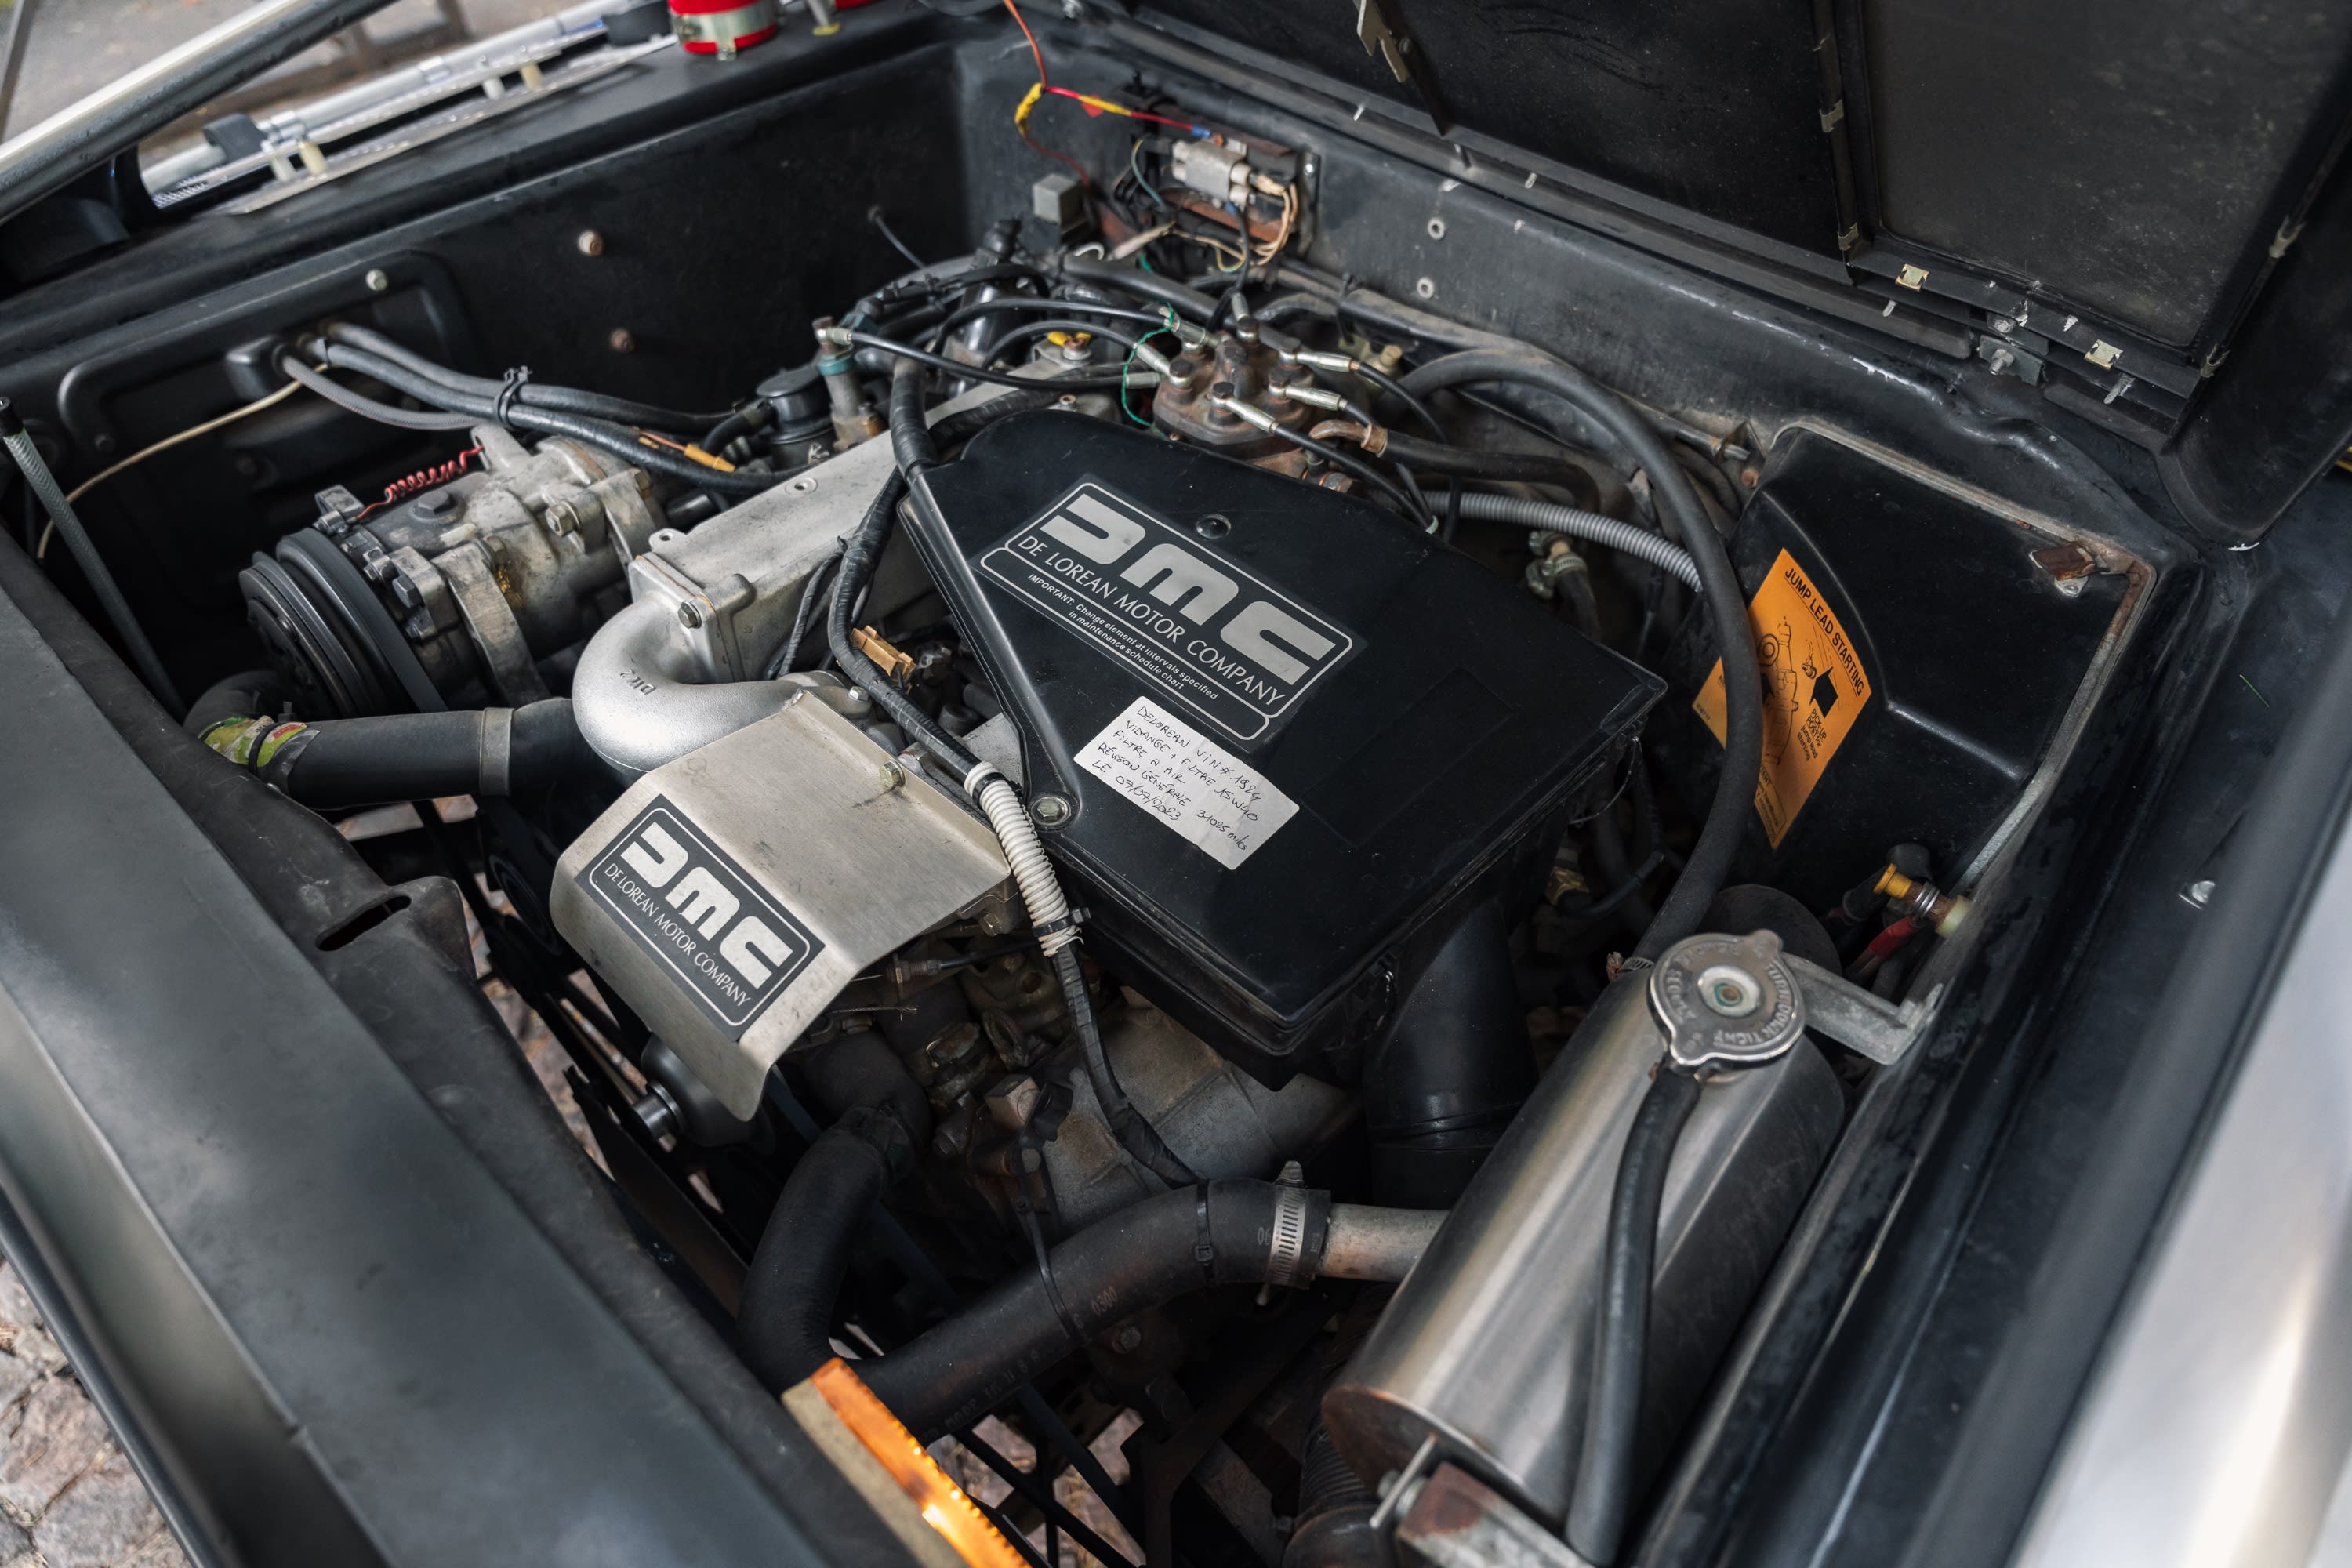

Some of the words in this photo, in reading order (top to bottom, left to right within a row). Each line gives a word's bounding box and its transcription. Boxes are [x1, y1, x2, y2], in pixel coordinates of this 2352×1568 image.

[1018, 535, 1047, 558] DE
[1044, 550, 1117, 601] LOREAN
[1113, 593, 1186, 644] MOTOR
[1186, 639, 1286, 707] COMPANY
[1027, 573, 1076, 607] IMPORTANT:
[1076, 603, 1105, 628] Change
[1103, 619, 1138, 647] element
[1134, 638, 1145, 651] at
[1143, 642, 1180, 676] intervals
[1178, 668, 1219, 701] specified
[1068, 611, 1078, 619] in
[1076, 613, 1127, 652] maintenance
[1124, 643, 1163, 680] schedule
[1160, 670, 1185, 691] chart
[1784, 567, 1811, 599] JUMP
[1809, 598, 1834, 636] LEAD
[1831, 633, 1865, 698] STARTING
[1137, 706, 1190, 749] DELOREAN
[1797, 732, 1811, 762] starting
[1806, 716, 1818, 739] POST
[1811, 708, 1827, 739] PICK-UP
[1092, 759, 1112, 774] LE
[604, 863, 623, 883] DE
[617, 879, 659, 917] LOREAN
[655, 913, 697, 956] MOTOR
[695, 952, 752, 1007] COMPANY
